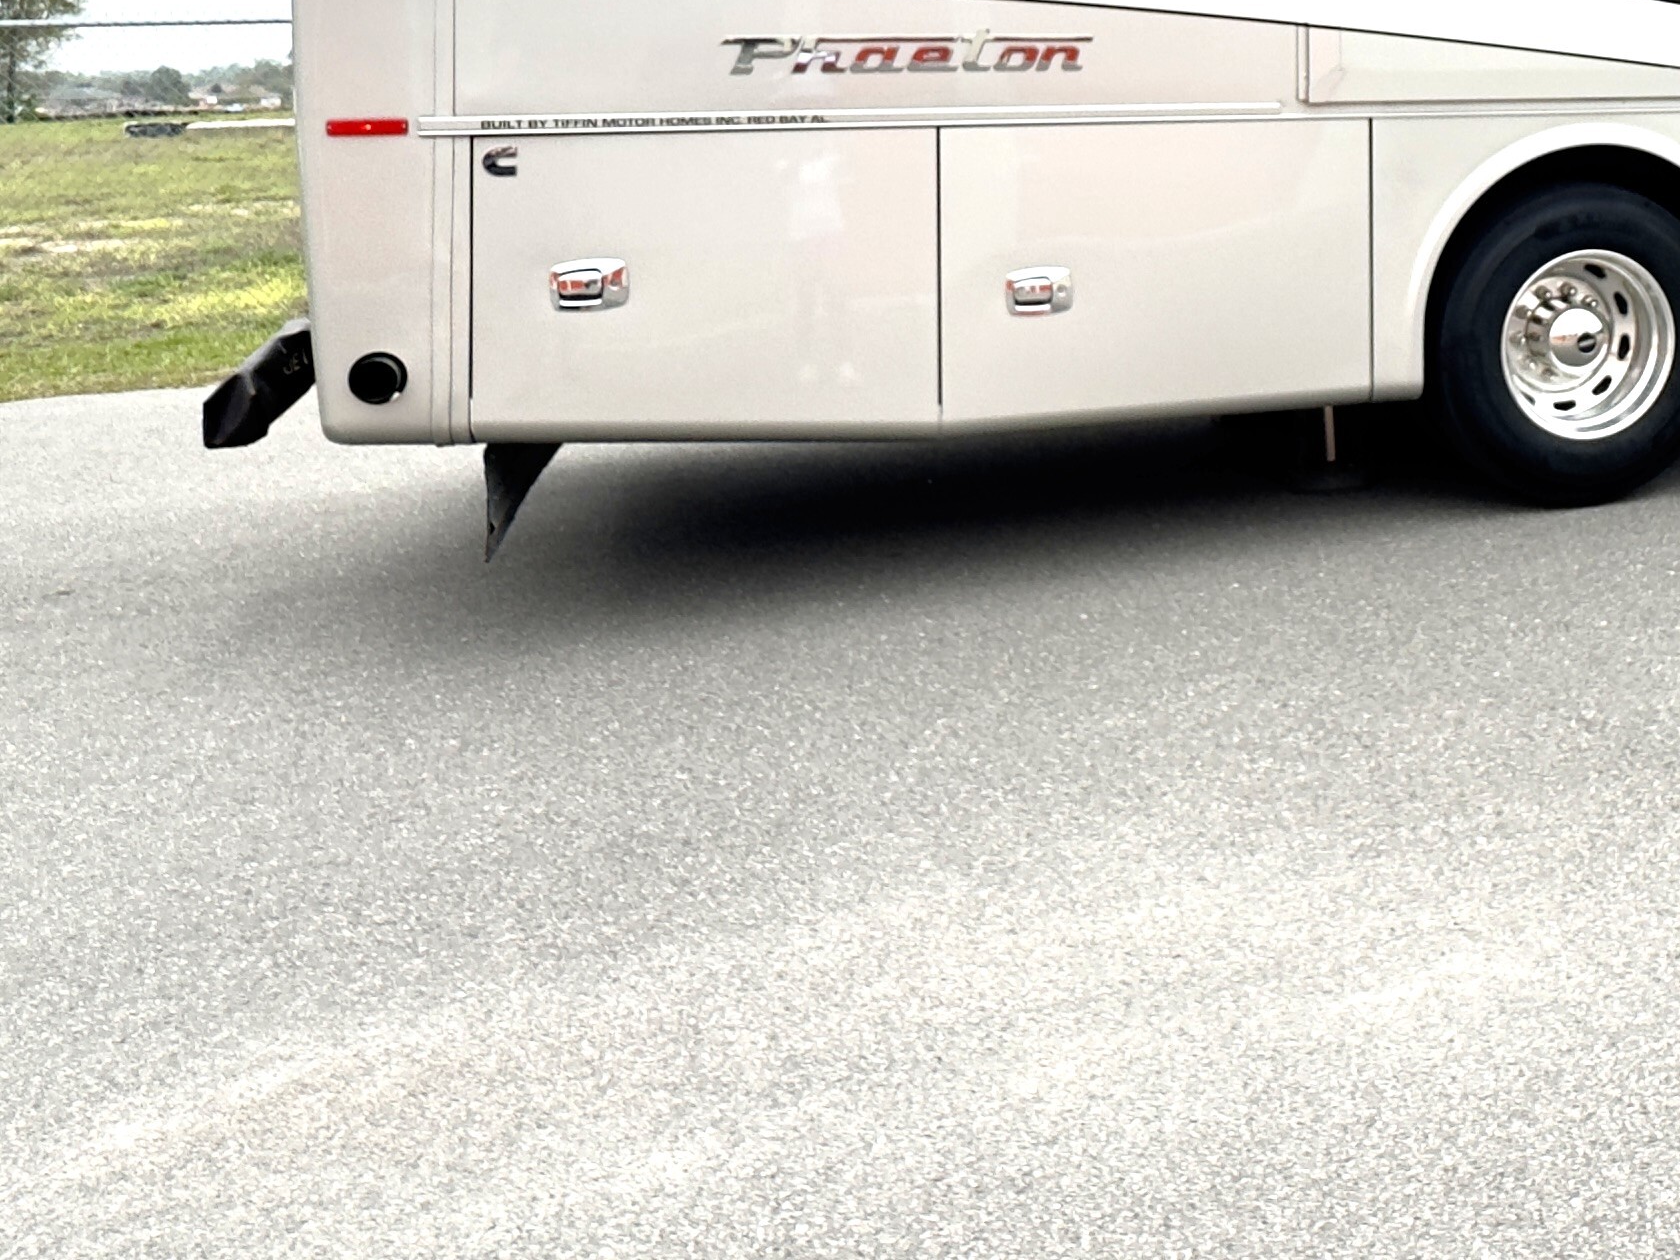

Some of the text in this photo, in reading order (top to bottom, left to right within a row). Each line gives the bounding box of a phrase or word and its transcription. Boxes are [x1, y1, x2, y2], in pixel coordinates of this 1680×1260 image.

[721, 28, 1093, 75] Phaeton
[481, 120, 522, 130] BUILT
[528, 120, 549, 130] BY
[553, 119, 598, 129] TIFFIN
[602, 118, 656, 128] MOTOR
[659, 117, 712, 127] HOMES
[747, 115, 776, 125] RED
